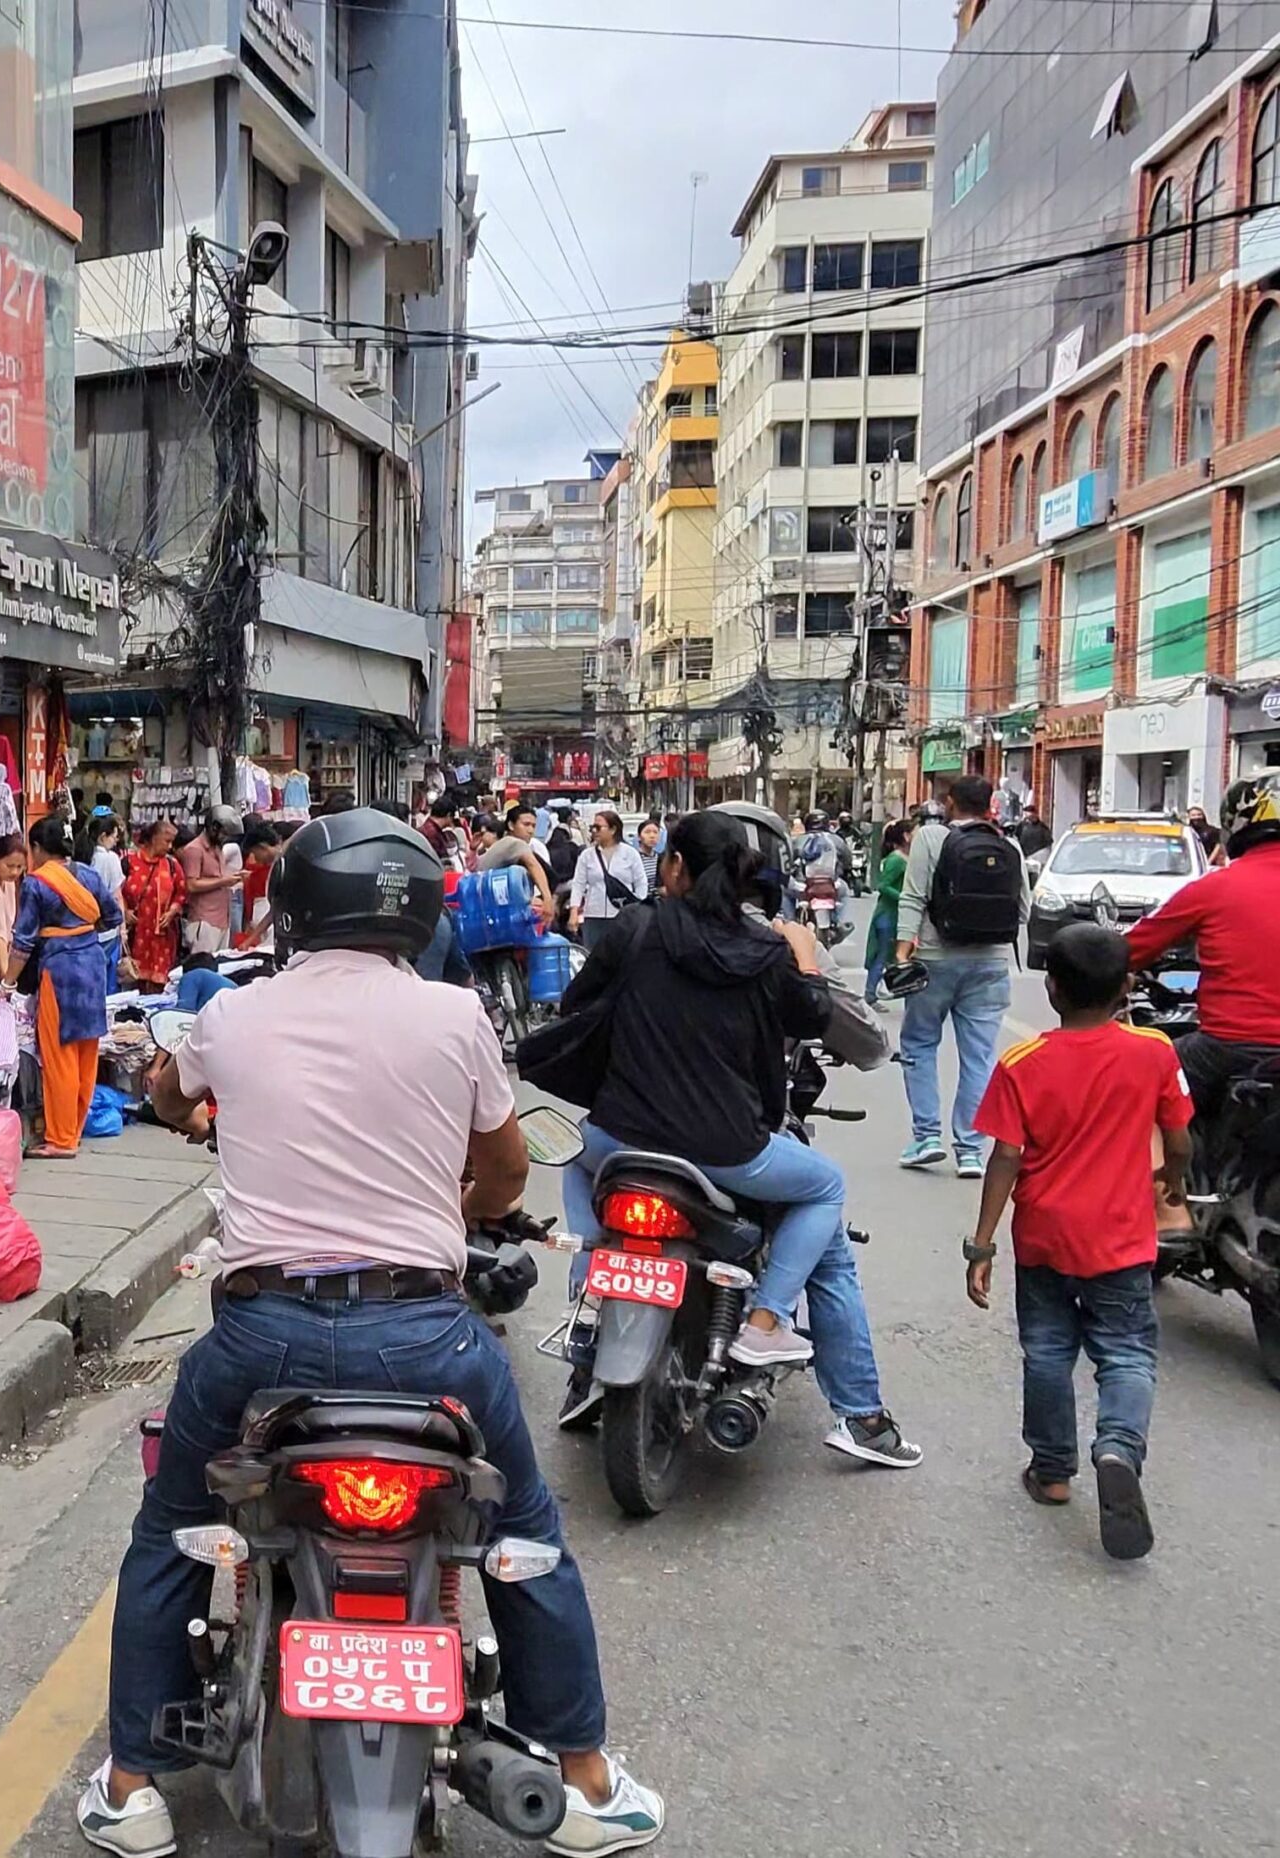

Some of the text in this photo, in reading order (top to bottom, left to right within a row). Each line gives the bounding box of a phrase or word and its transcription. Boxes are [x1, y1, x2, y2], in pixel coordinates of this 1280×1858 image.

[61, 557, 119, 613] Nepal
[591, 1270, 676, 1301] ६०५२
[303, 1656, 433, 1684] ०५८ प
[294, 1681, 448, 1715] ८२६८
